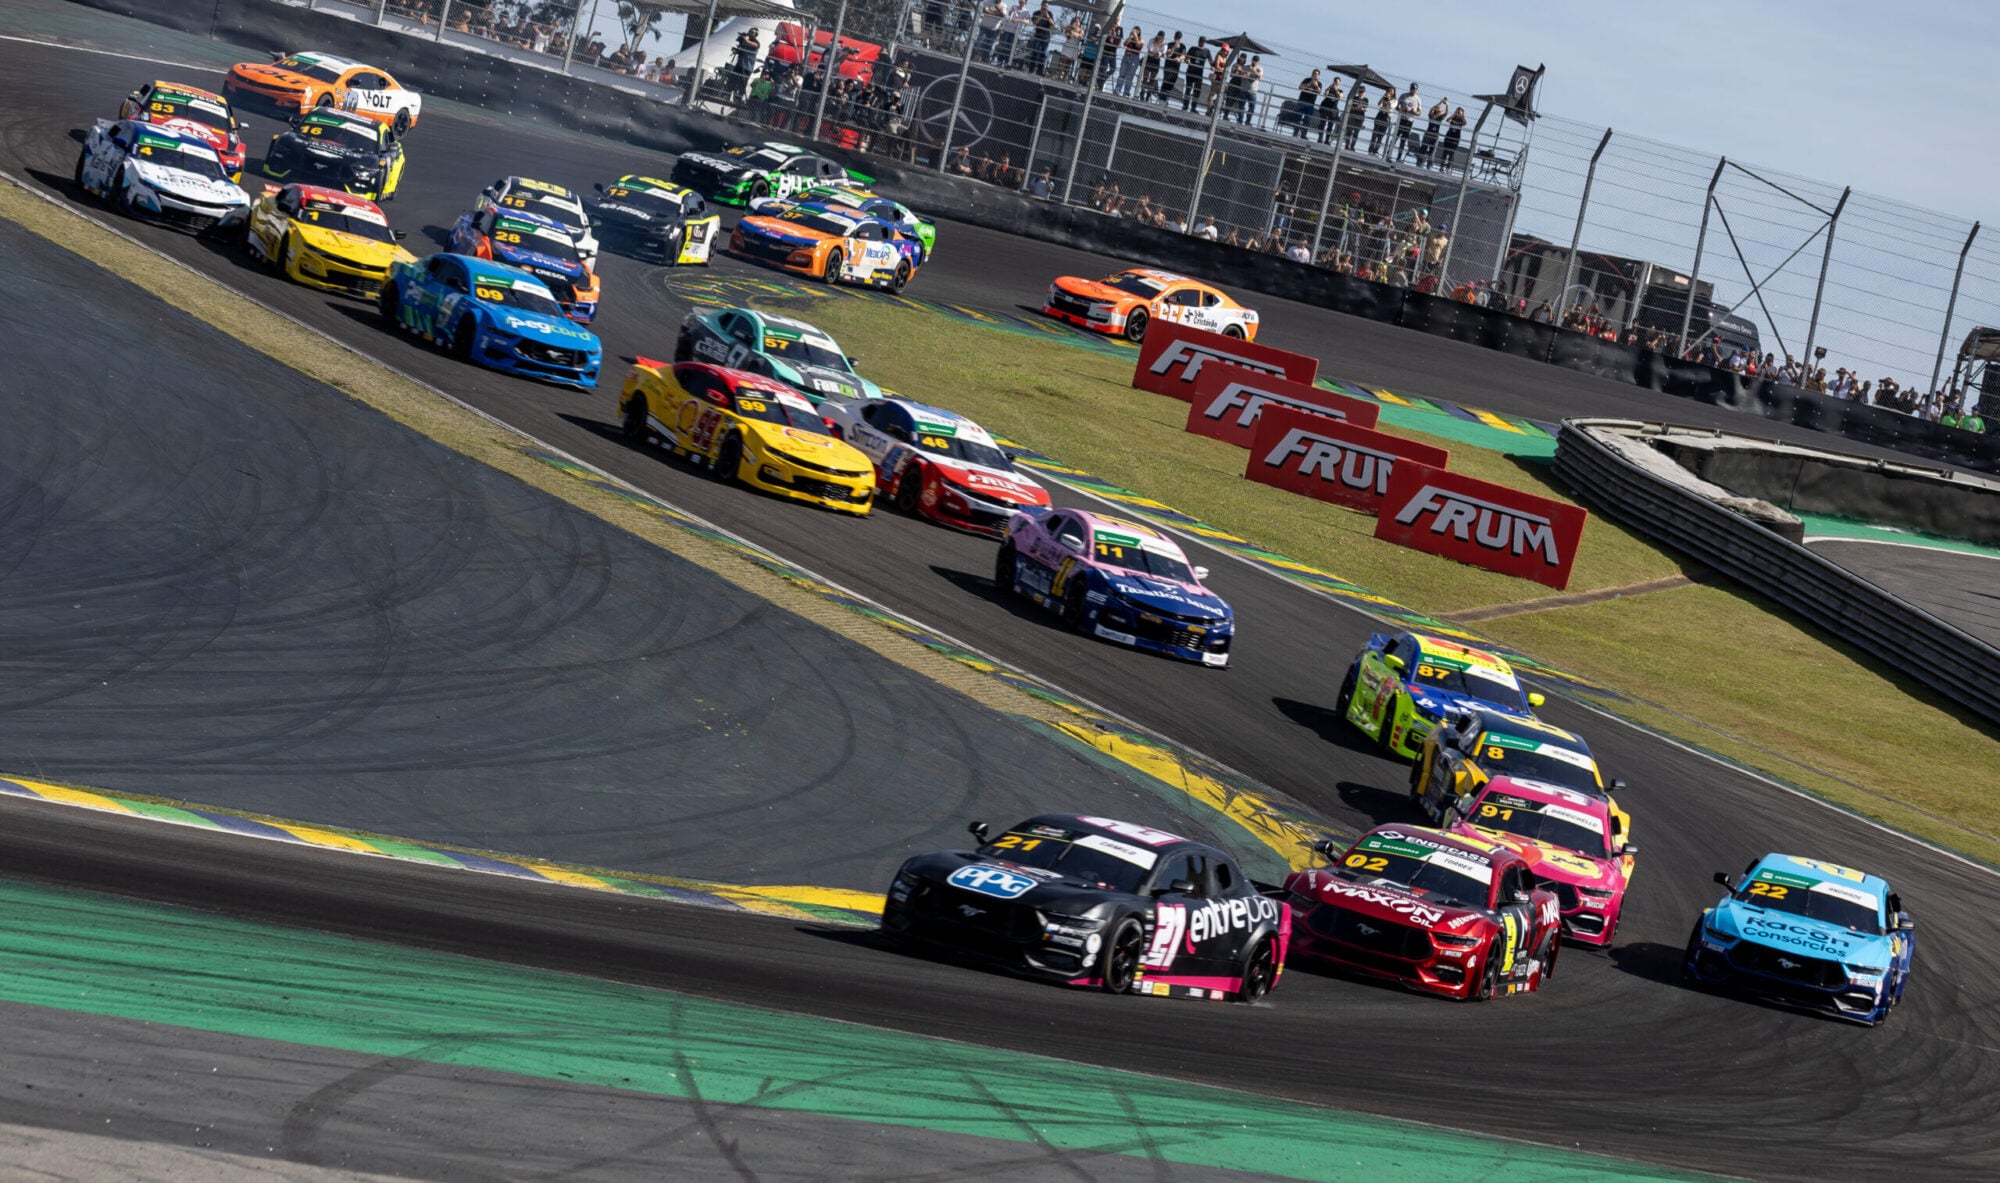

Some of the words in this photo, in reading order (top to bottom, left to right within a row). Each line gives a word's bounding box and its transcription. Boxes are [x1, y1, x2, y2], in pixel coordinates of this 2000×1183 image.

[150, 102, 175, 113] 83
[362, 91, 392, 109] VOLT
[300, 126, 323, 135] 16
[139, 147, 153, 156] 4
[610, 188, 629, 197] 12
[504, 196, 526, 208] 15
[308, 211, 319, 221] 1
[495, 231, 521, 244] 28
[535, 268, 568, 282] CRESOL
[476, 287, 504, 302] 09
[764, 338, 790, 350] 57
[738, 399, 767, 413] 99
[921, 435, 950, 450] 46
[1395, 484, 1560, 565] FRUM
[1096, 544, 1123, 559] 11
[1417, 664, 1451, 680] 87
[1487, 746, 1504, 760] 8
[1480, 804, 1514, 821] 91
[1551, 808, 1599, 827] BARRICHELLO
[993, 835, 1043, 851] 21
[1099, 840, 1137, 856] CAMILO
[1404, 836, 1490, 865] ENGECASS
[1344, 853, 1389, 872] 02
[1443, 857, 1474, 871] TORRES
[955, 867, 1029, 893] PPG
[1748, 881, 1789, 900] 22
[1827, 886, 1863, 900] ANDRADE
[1322, 883, 1443, 923] MAXON
[1190, 895, 1279, 943] entrepay
[1409, 915, 1434, 929] OIL
[1742, 926, 1847, 958] Consórcios
